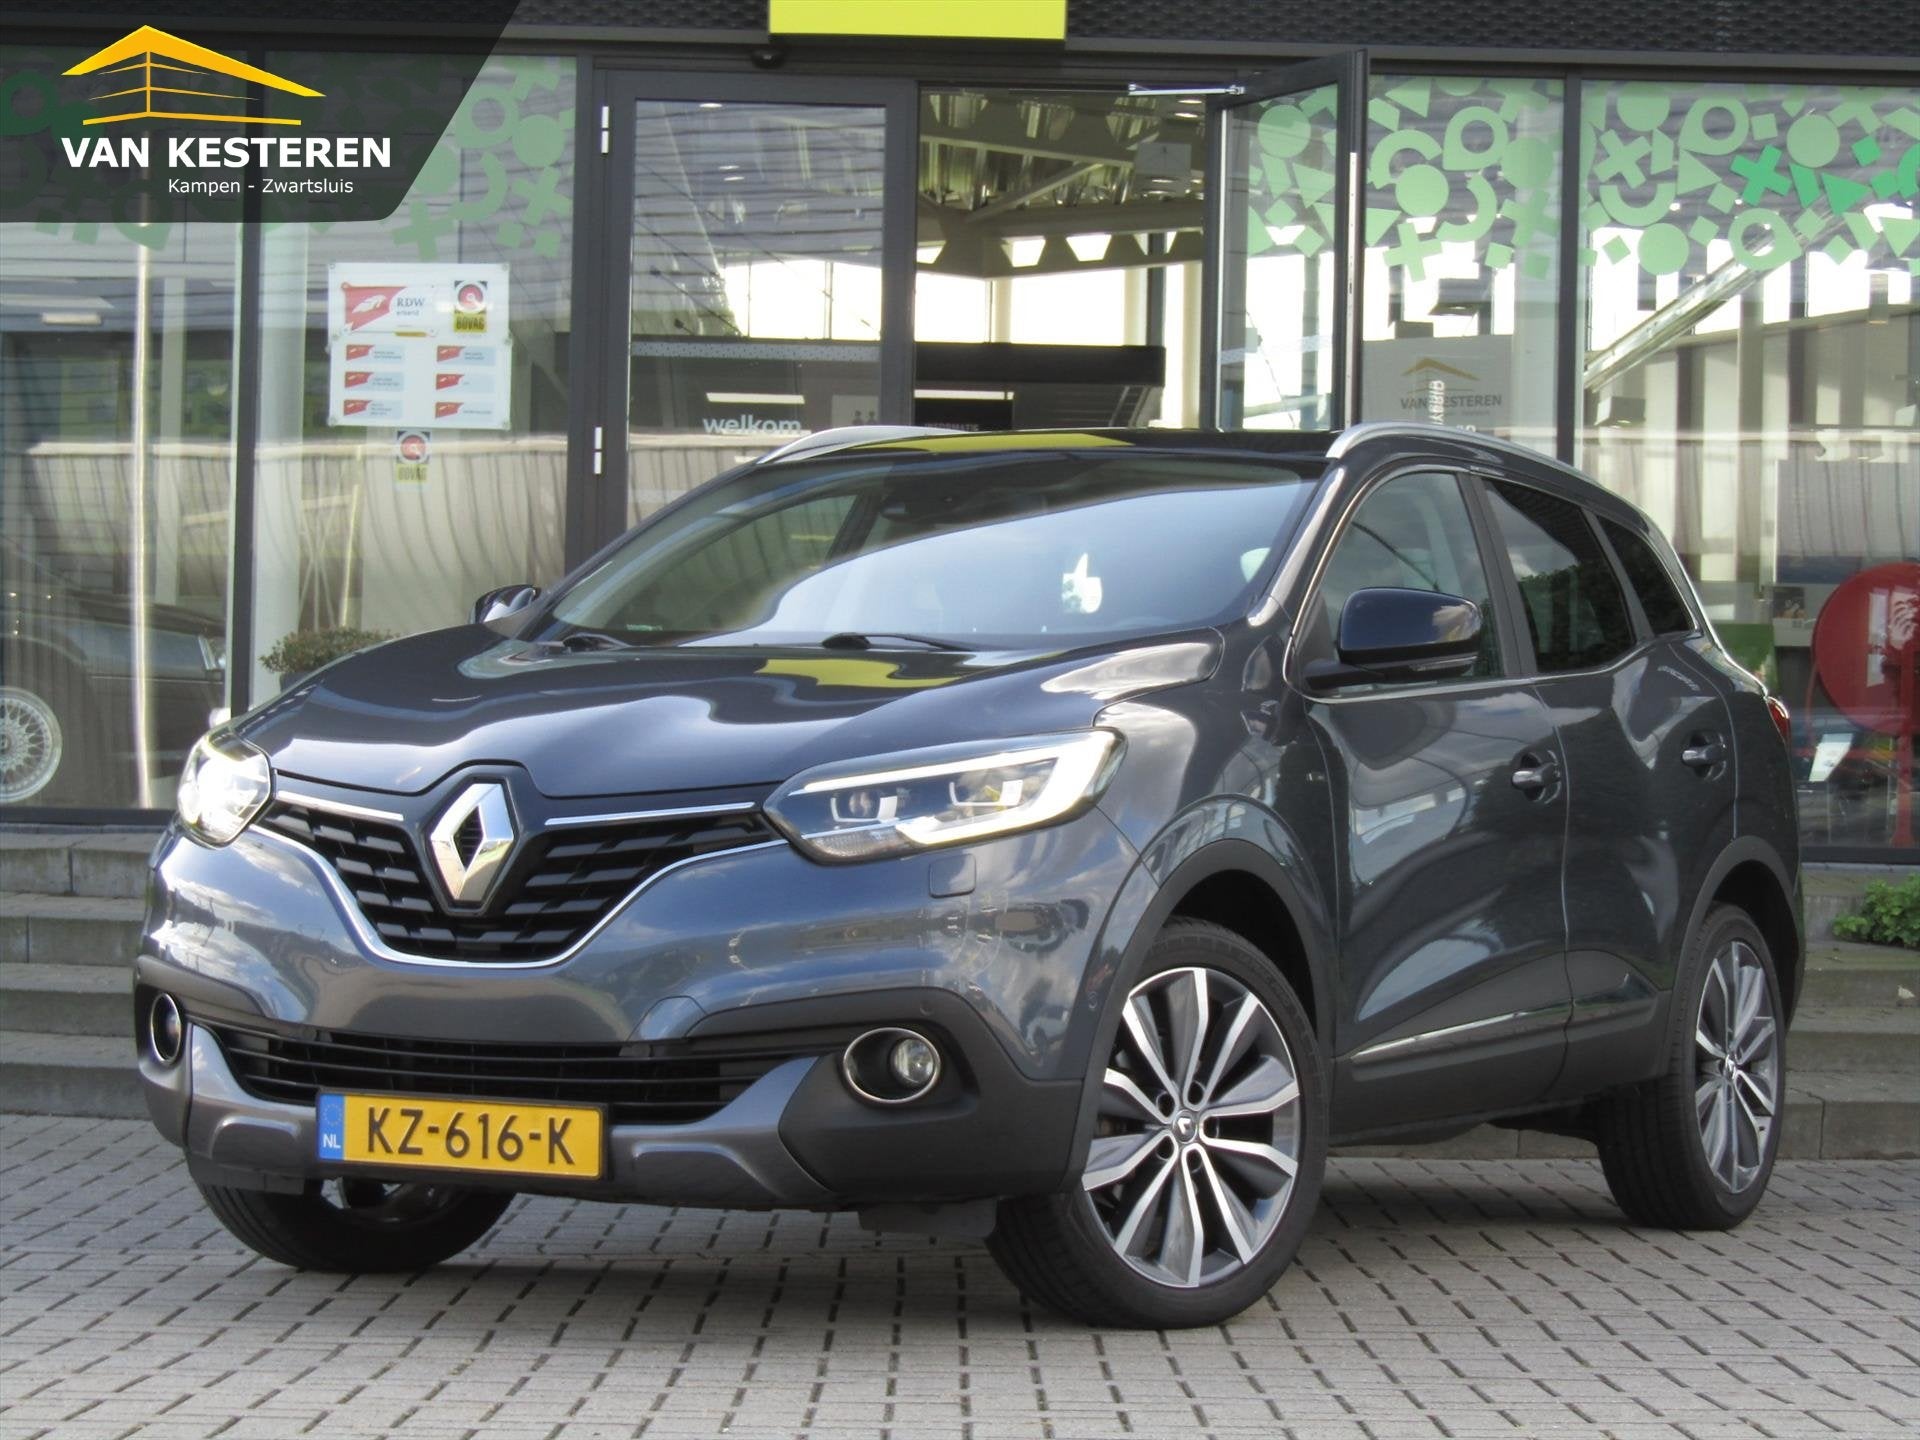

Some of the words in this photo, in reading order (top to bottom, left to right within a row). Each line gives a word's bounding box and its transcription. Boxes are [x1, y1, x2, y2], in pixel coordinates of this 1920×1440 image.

[396, 297, 425, 307] RDW
[456, 316, 485, 330] BOVAG
[1400, 397, 1429, 410] VAN
[1430, 394, 1503, 409] ESTEREN
[702, 414, 801, 434] welkom
[322, 1133, 341, 1149] NL
[367, 1106, 575, 1165] KZ-616-K
